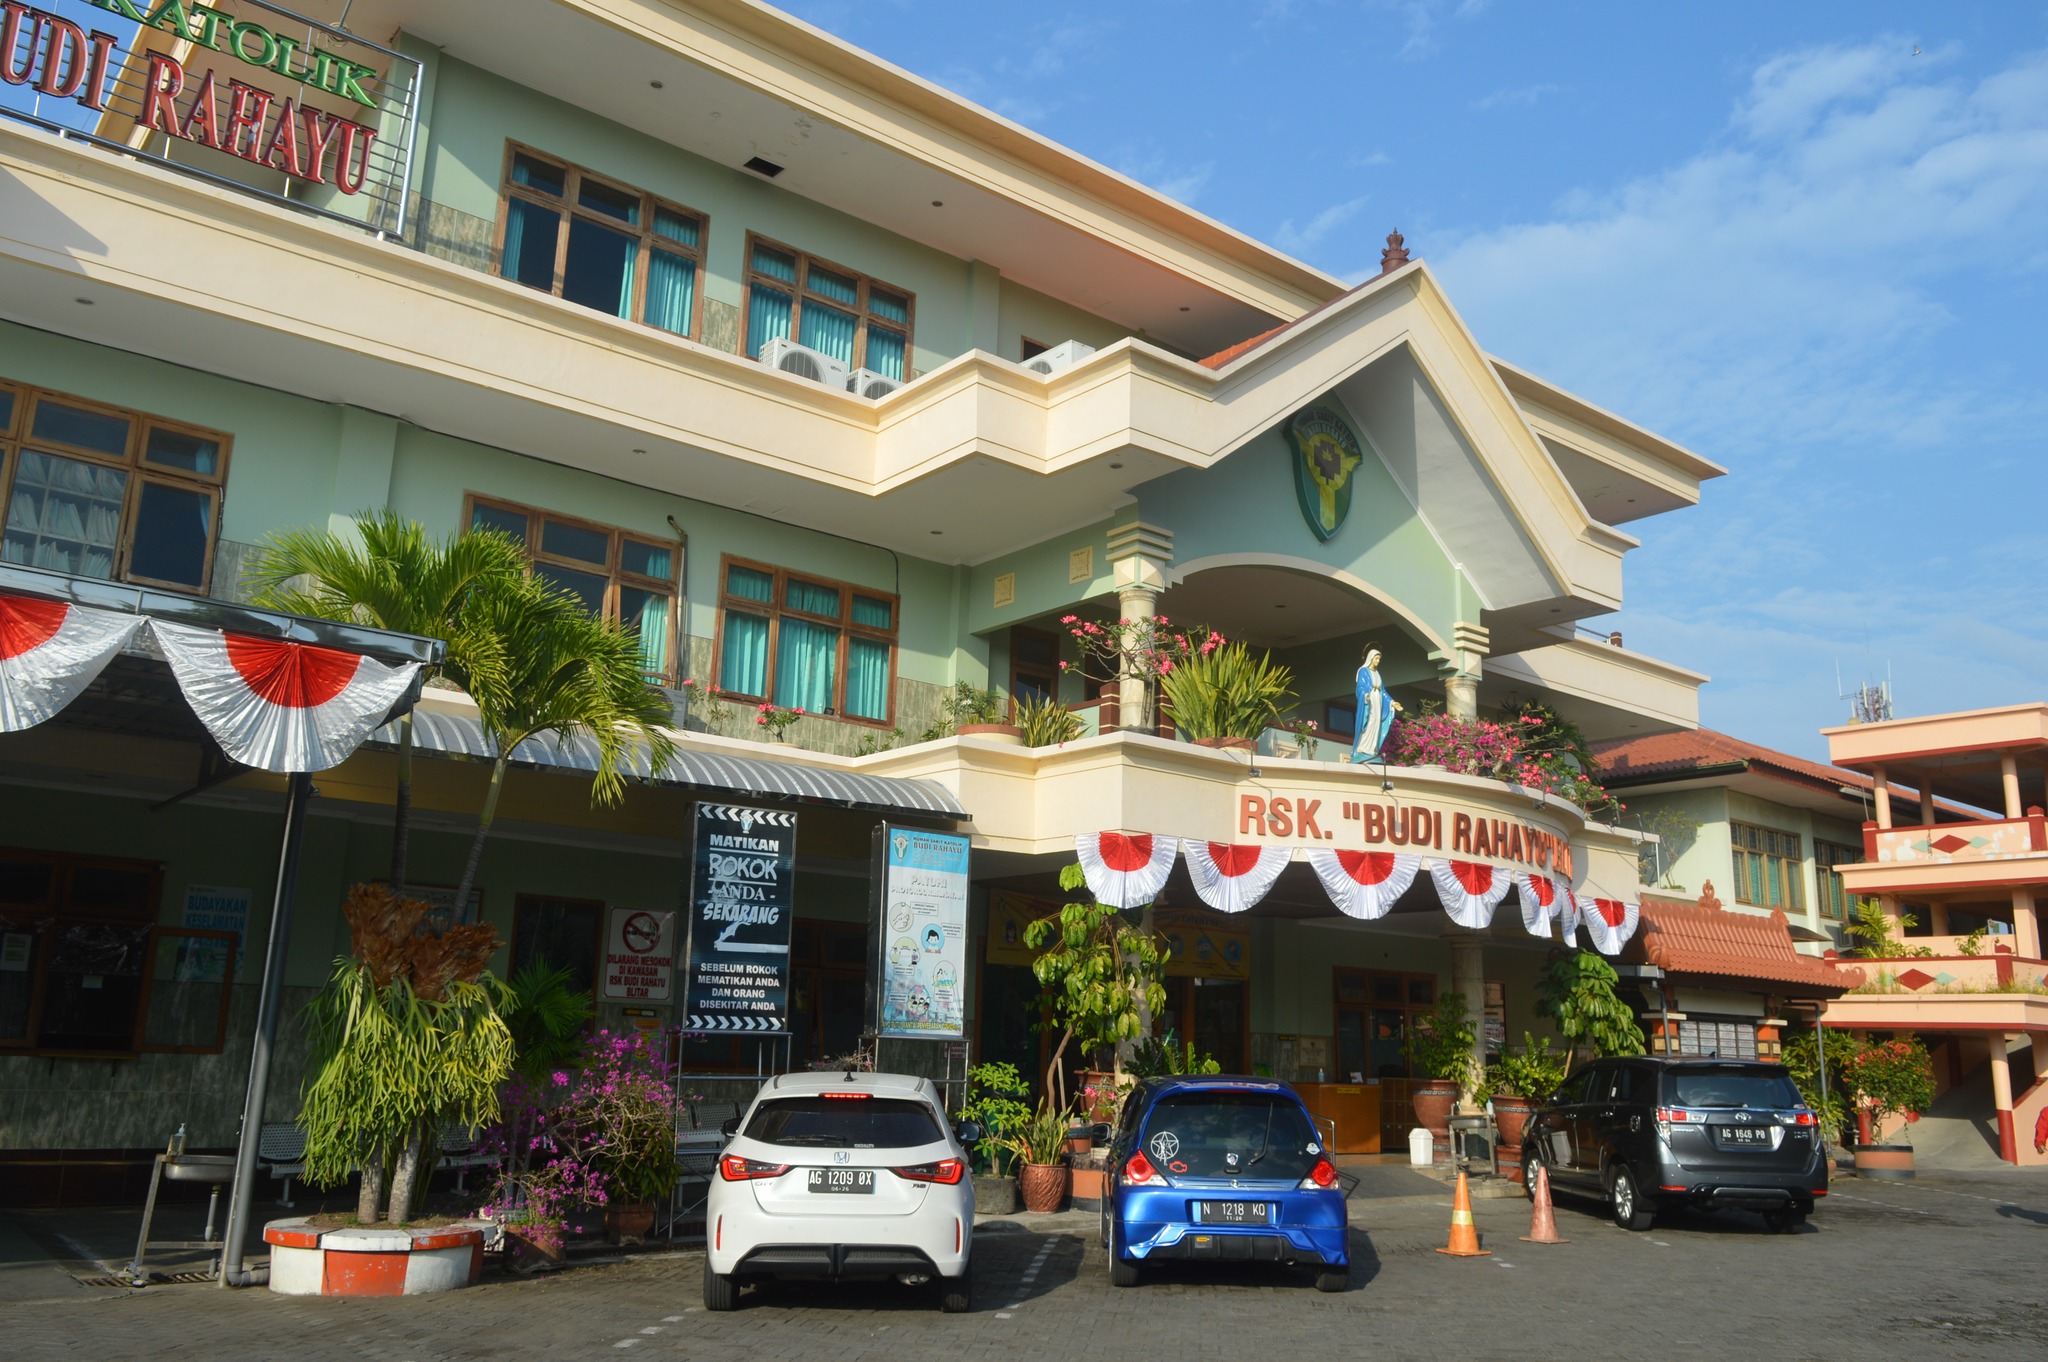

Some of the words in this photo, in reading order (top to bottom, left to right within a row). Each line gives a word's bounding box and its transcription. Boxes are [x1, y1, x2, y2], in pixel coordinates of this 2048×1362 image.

[135, 48, 379, 195] RAHAYU
[1239, 793, 1333, 839] RSK.
[710, 834, 779, 852] MATIKAN
[913, 841, 931, 850] BUDI
[933, 844, 962, 854] RAHAYU
[709, 853, 778, 880] ROKOK
[187, 895, 248, 913] BUDAYAKAN
[703, 902, 779, 925] SEKARANG
[185, 912, 245, 931] KESELAMATAN
[607, 953, 639, 965] DILARANG
[641, 956, 672, 967] MEROKOK
[619, 965, 626, 975] DI
[627, 966, 658, 977] KAWASAN
[701, 962, 744, 973] SEBELUM
[746, 965, 778, 975] ROKOK
[609, 975, 623, 985] RSK
[624, 976, 639, 986] BUDI
[640, 977, 666, 988] RAHAYU
[698, 975, 753, 986] MEMATIKAN
[755, 977, 780, 987] ANDA
[627, 987, 649, 997] BLITAR
[712, 988, 731, 997] DAN
[733, 989, 765, 998] ORANG
[700, 1000, 748, 1009] DISEKITAR
[751, 1001, 776, 1011] ANDA
[809, 1170, 822, 1185] AG
[828, 1171, 853, 1185] 1209
[1203, 1203, 1210, 1215] N
[1222, 1203, 1245, 1215] 1218
[1252, 1204, 1266, 1216] KQ
